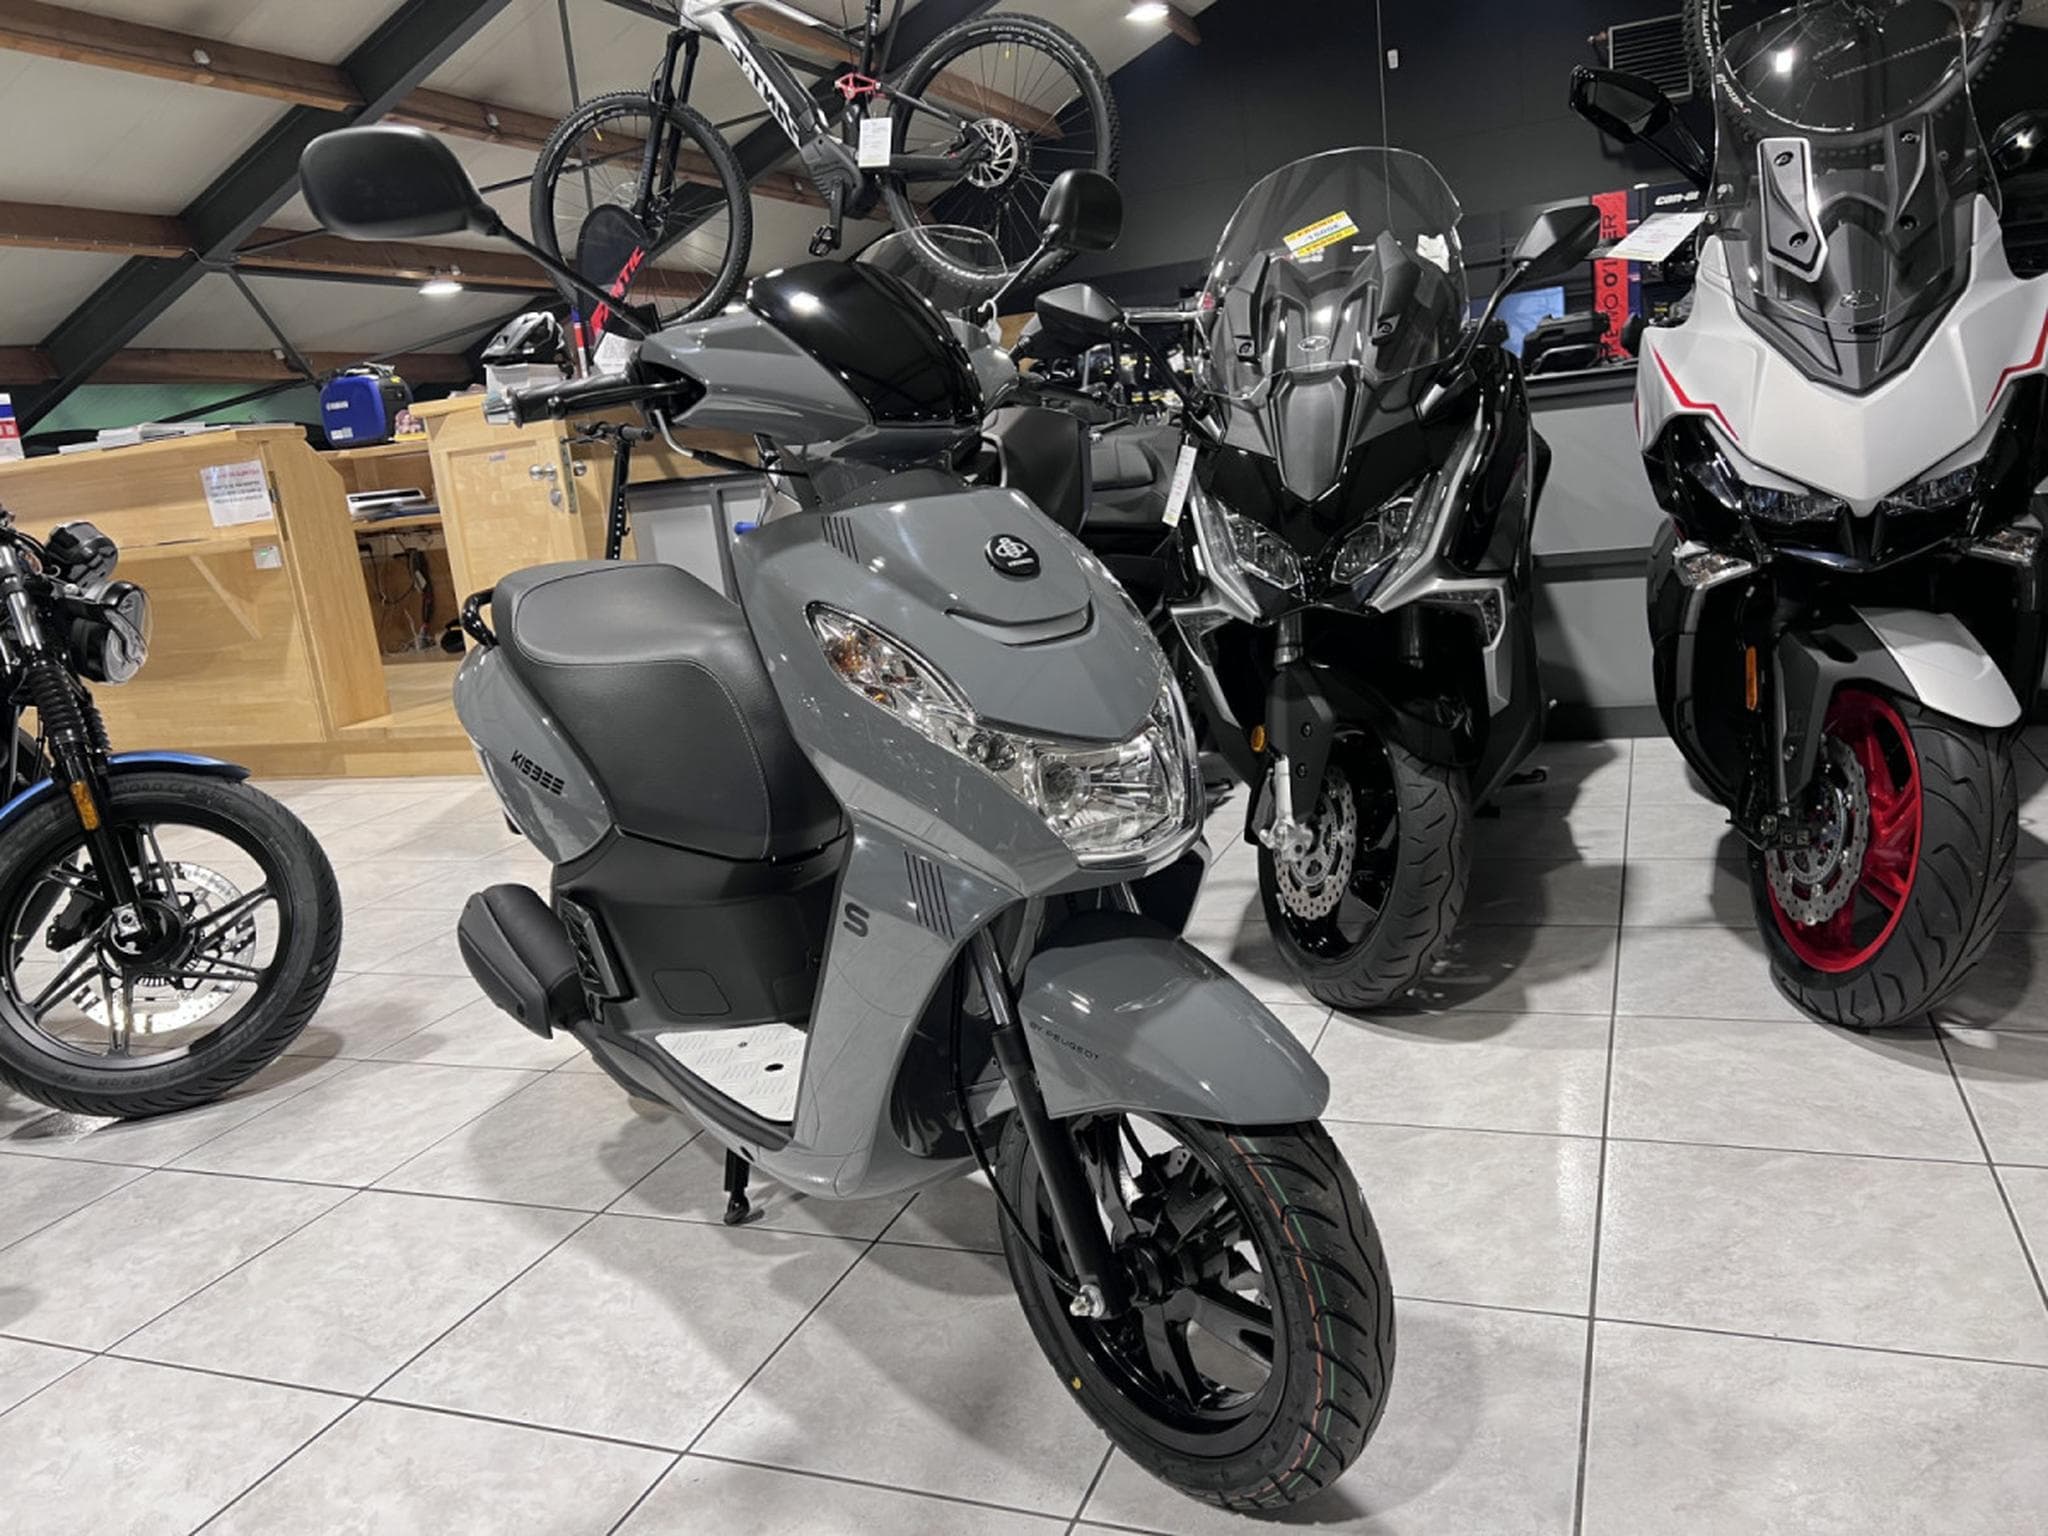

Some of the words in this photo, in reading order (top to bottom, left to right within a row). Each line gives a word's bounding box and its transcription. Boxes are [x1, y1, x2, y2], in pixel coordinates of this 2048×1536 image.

[510, 750, 565, 796] KISBEE
[843, 902, 870, 938] S
[1046, 1029, 1099, 1060] PEUGEOT
